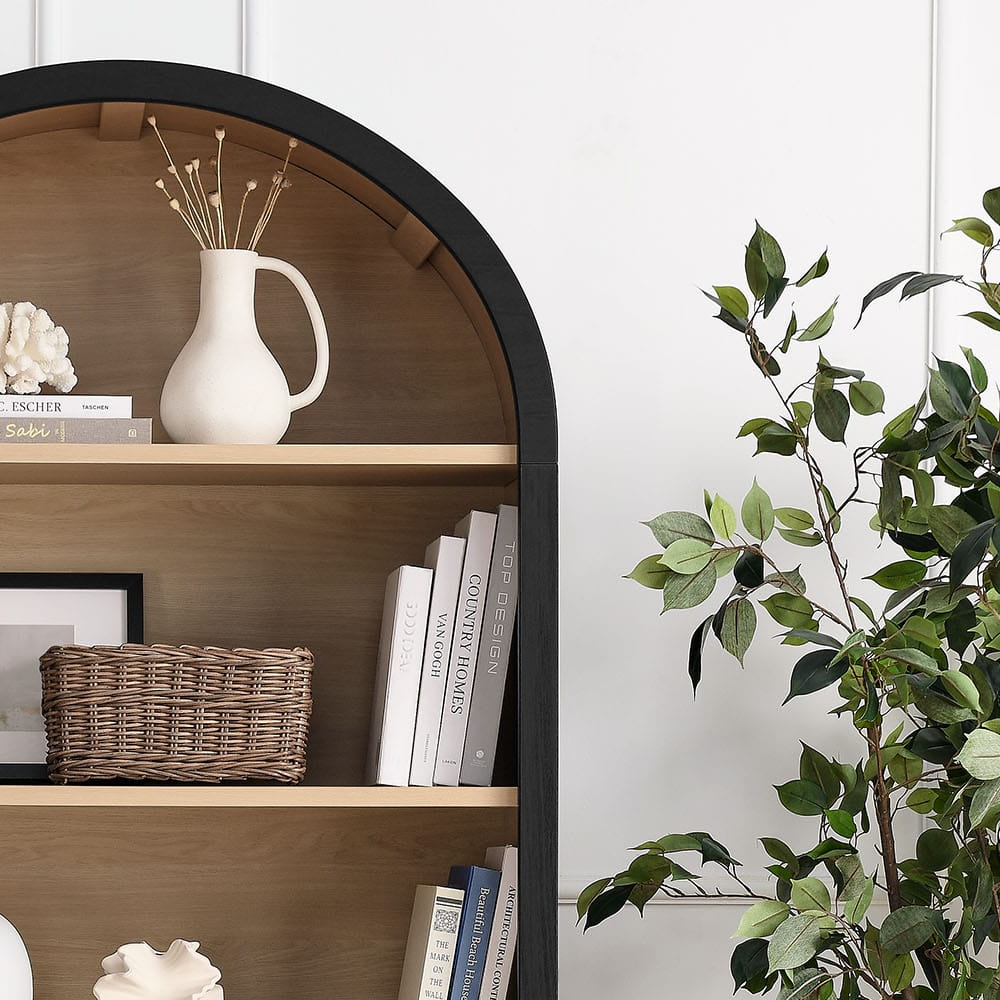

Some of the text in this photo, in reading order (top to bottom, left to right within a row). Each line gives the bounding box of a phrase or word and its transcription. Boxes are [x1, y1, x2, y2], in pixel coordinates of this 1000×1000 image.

[12, 401, 62, 412] ESCHER
[5, 423, 51, 438] Sabi
[488, 541, 516, 675] TOP DESIGN
[431, 613, 448, 677] VAN GOGH
[451, 574, 482, 714] COUNTRY HOMES
[473, 887, 490, 934] Beautiful
[495, 885, 517, 968] ARCHITECTURAL
[435, 940, 449, 950] THE
[468, 936, 481, 966] Beach
[430, 952, 450, 962] MARK
[433, 966, 443, 974] ON
[429, 978, 443, 987] THE
[425, 990, 443, 1000] WALL
